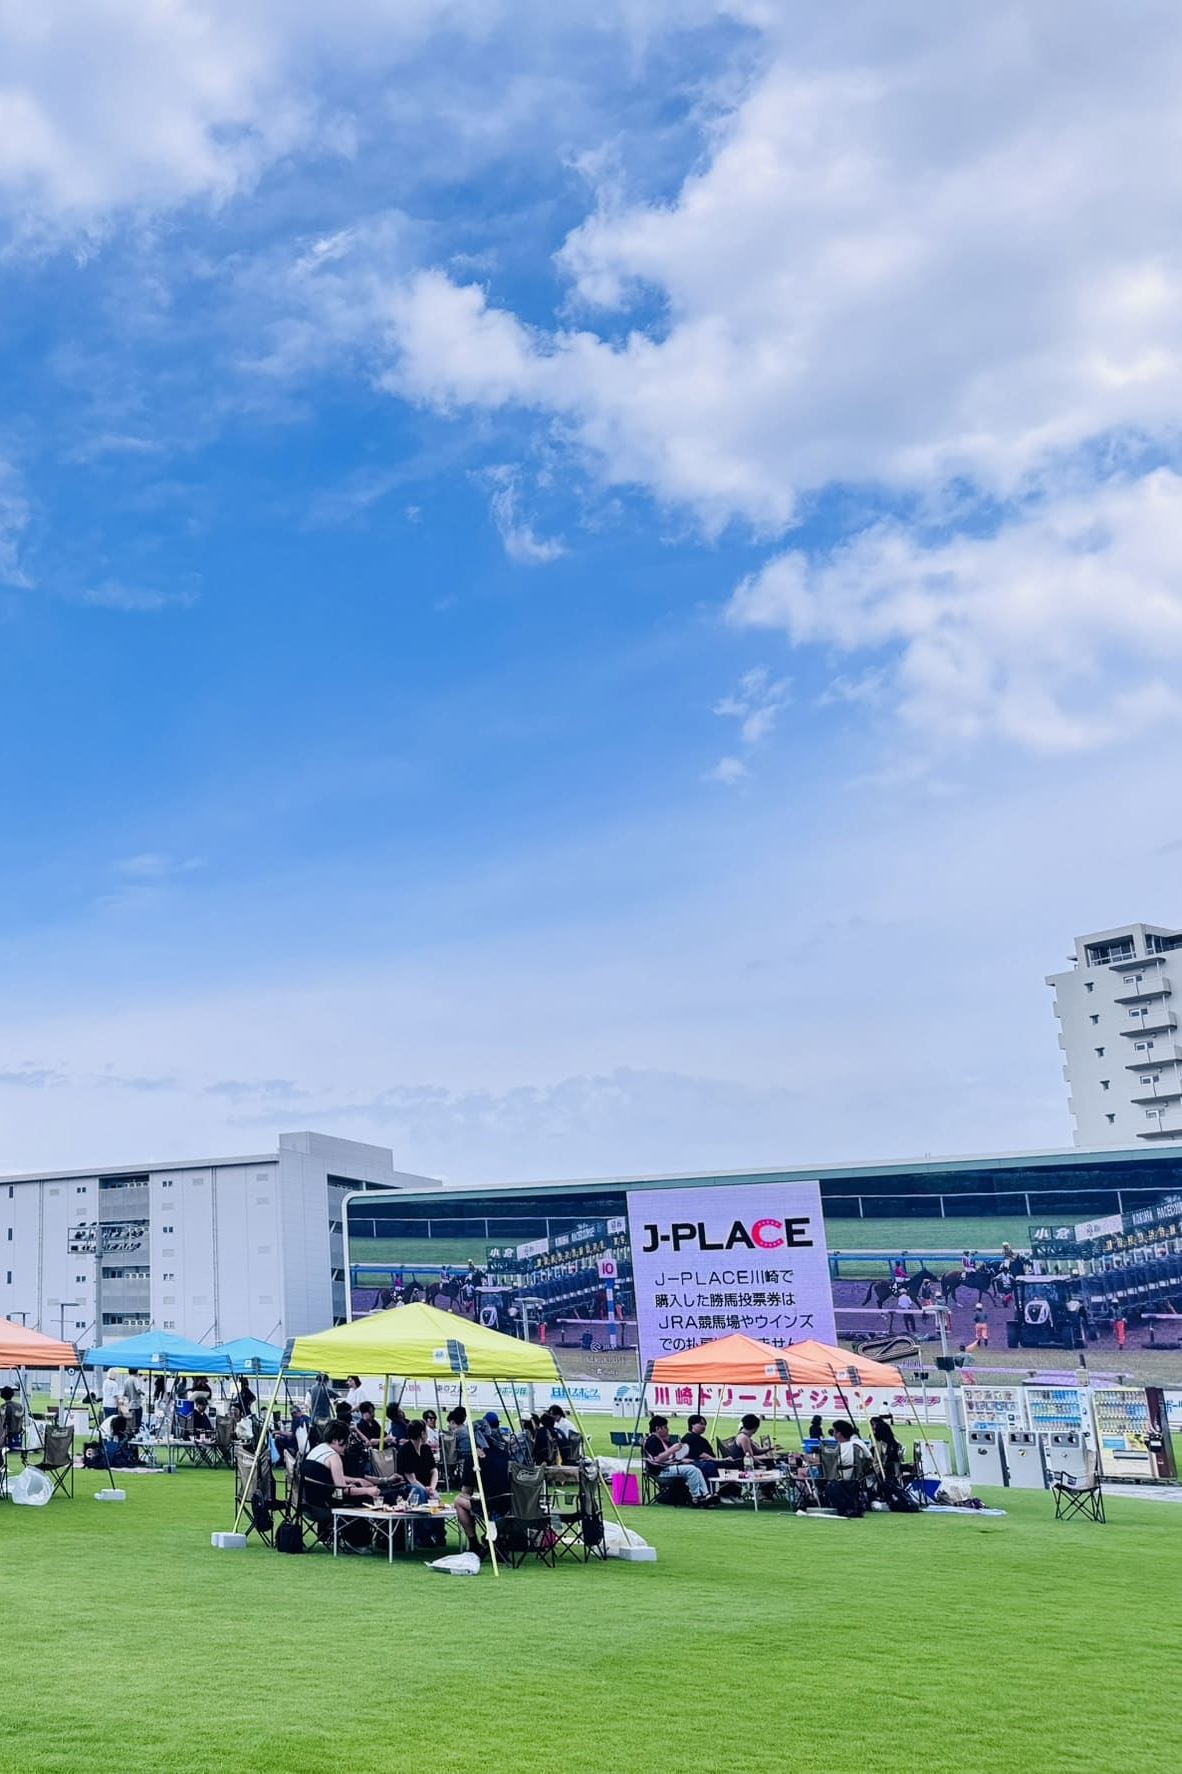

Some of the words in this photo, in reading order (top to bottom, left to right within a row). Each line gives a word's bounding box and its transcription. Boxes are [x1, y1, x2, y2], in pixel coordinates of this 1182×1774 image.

[642, 1217, 813, 1252] J-PLACE
[602, 1262, 614, 1275] 10
[654, 1291, 796, 1309] 購入した勝馬投票券は
